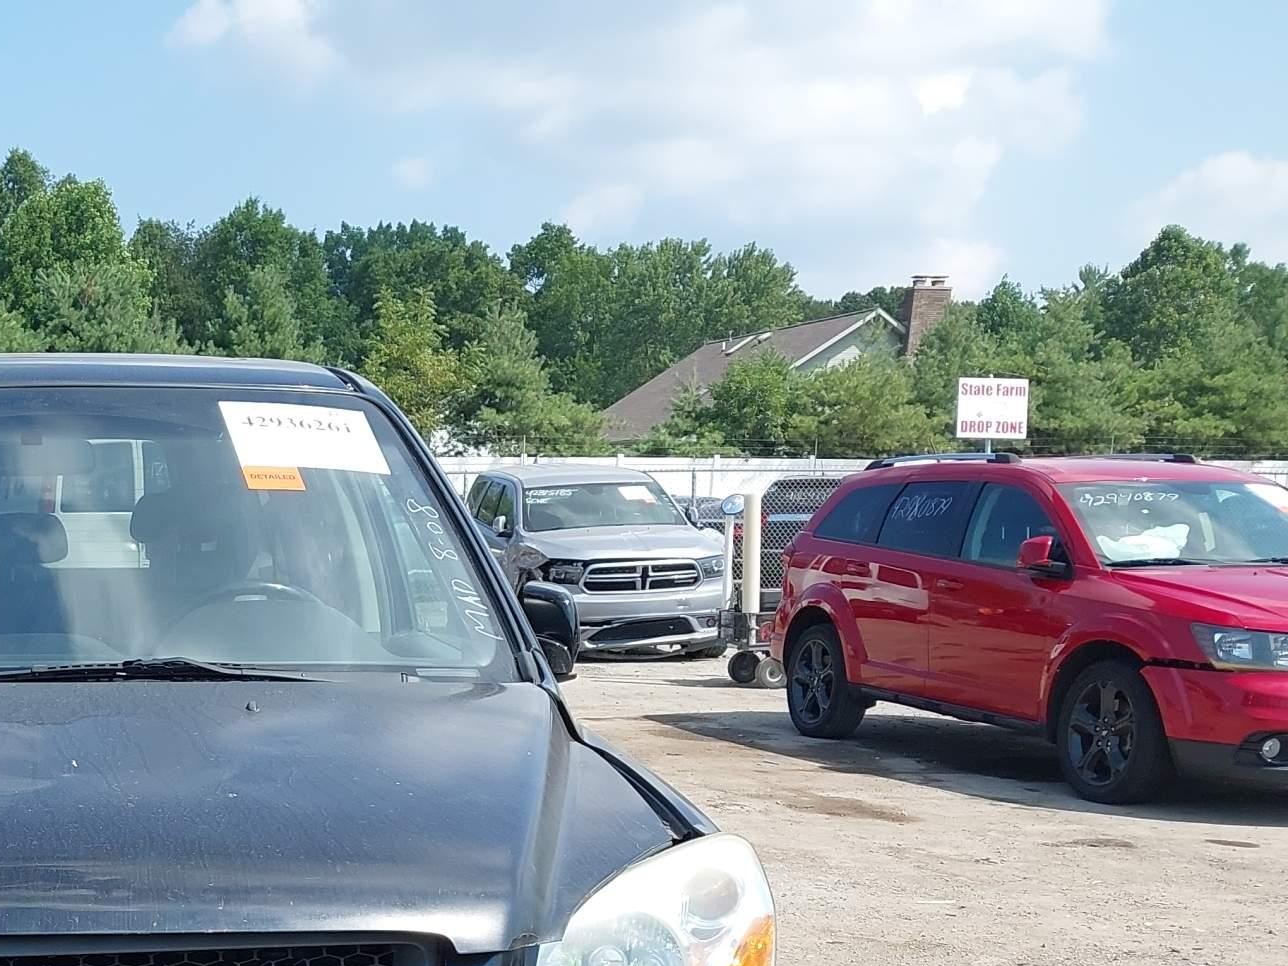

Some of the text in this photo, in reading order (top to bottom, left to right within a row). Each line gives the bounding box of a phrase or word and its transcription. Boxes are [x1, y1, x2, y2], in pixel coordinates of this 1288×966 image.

[961, 383, 1026, 397] State Farm
[961, 420, 1024, 434] DROP ZONE
[249, 473, 297, 482] DETAILED
